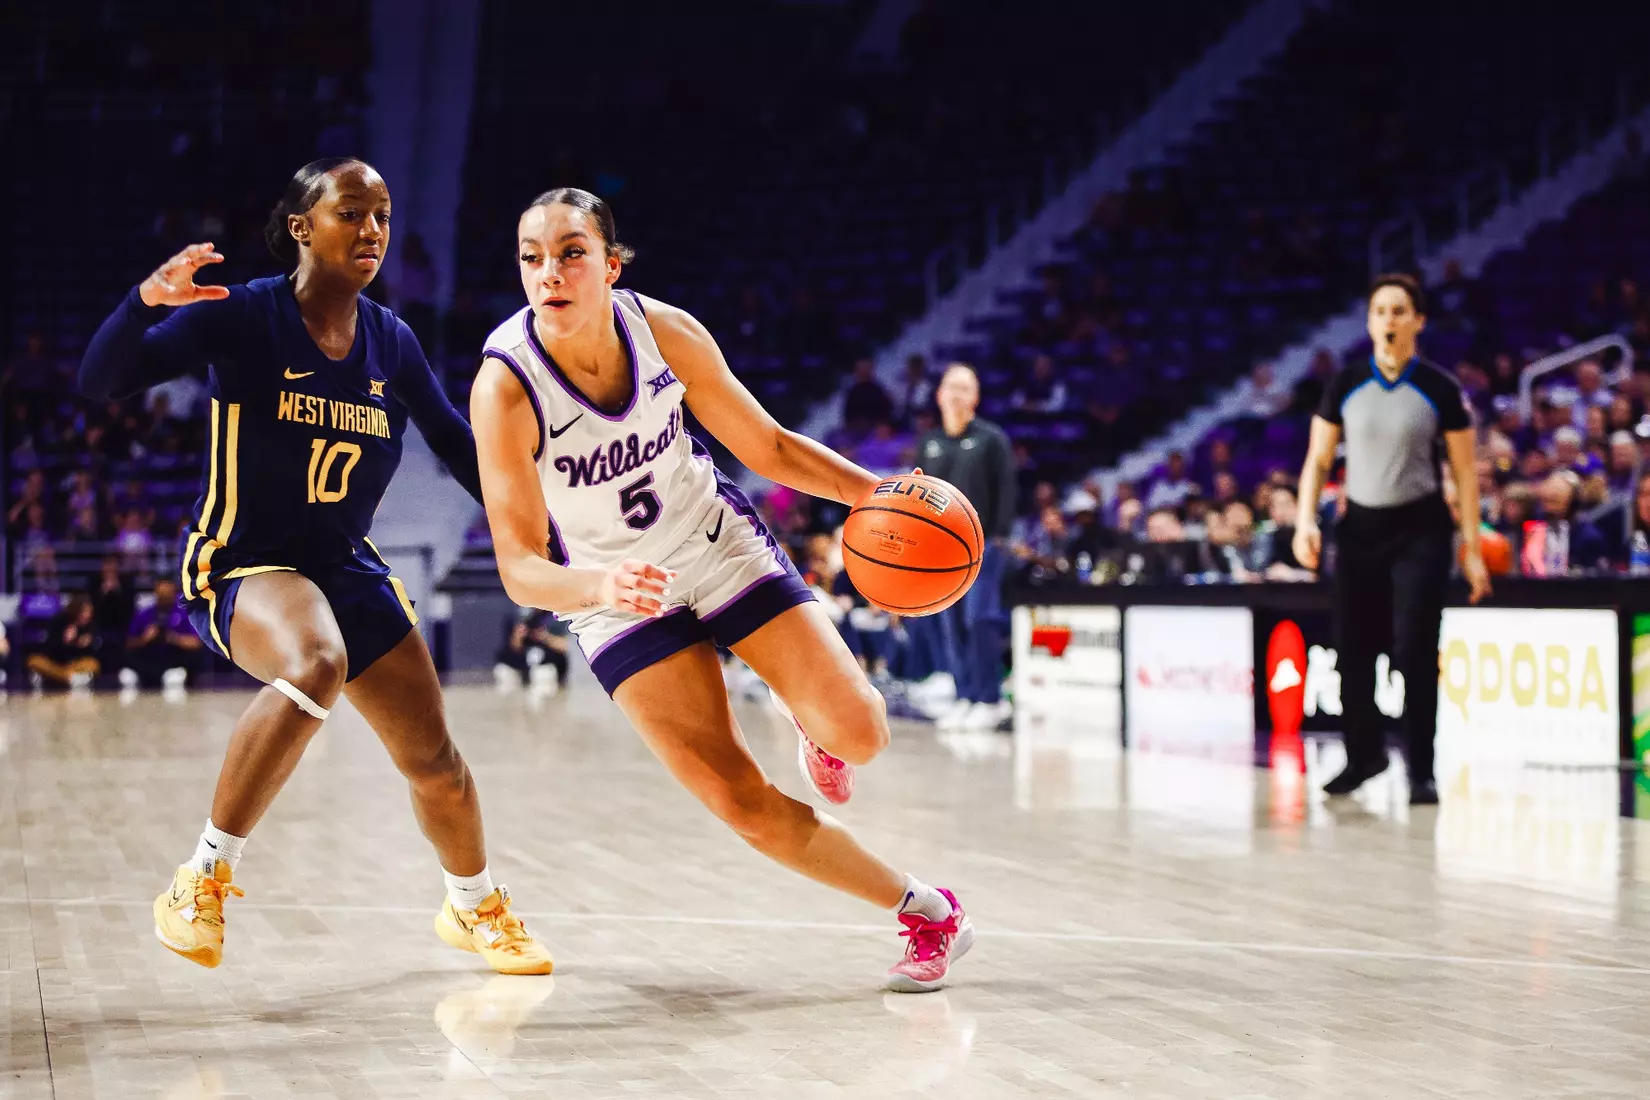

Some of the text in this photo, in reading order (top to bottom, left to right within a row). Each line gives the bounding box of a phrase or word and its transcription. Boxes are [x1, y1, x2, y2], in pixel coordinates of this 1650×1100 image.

[278, 391, 391, 438] WEST VIRGINIA
[308, 438, 362, 503] 10
[874, 481, 950, 513] ELITE
[618, 471, 663, 531] 5
[1444, 638, 1609, 722] QDOBA
